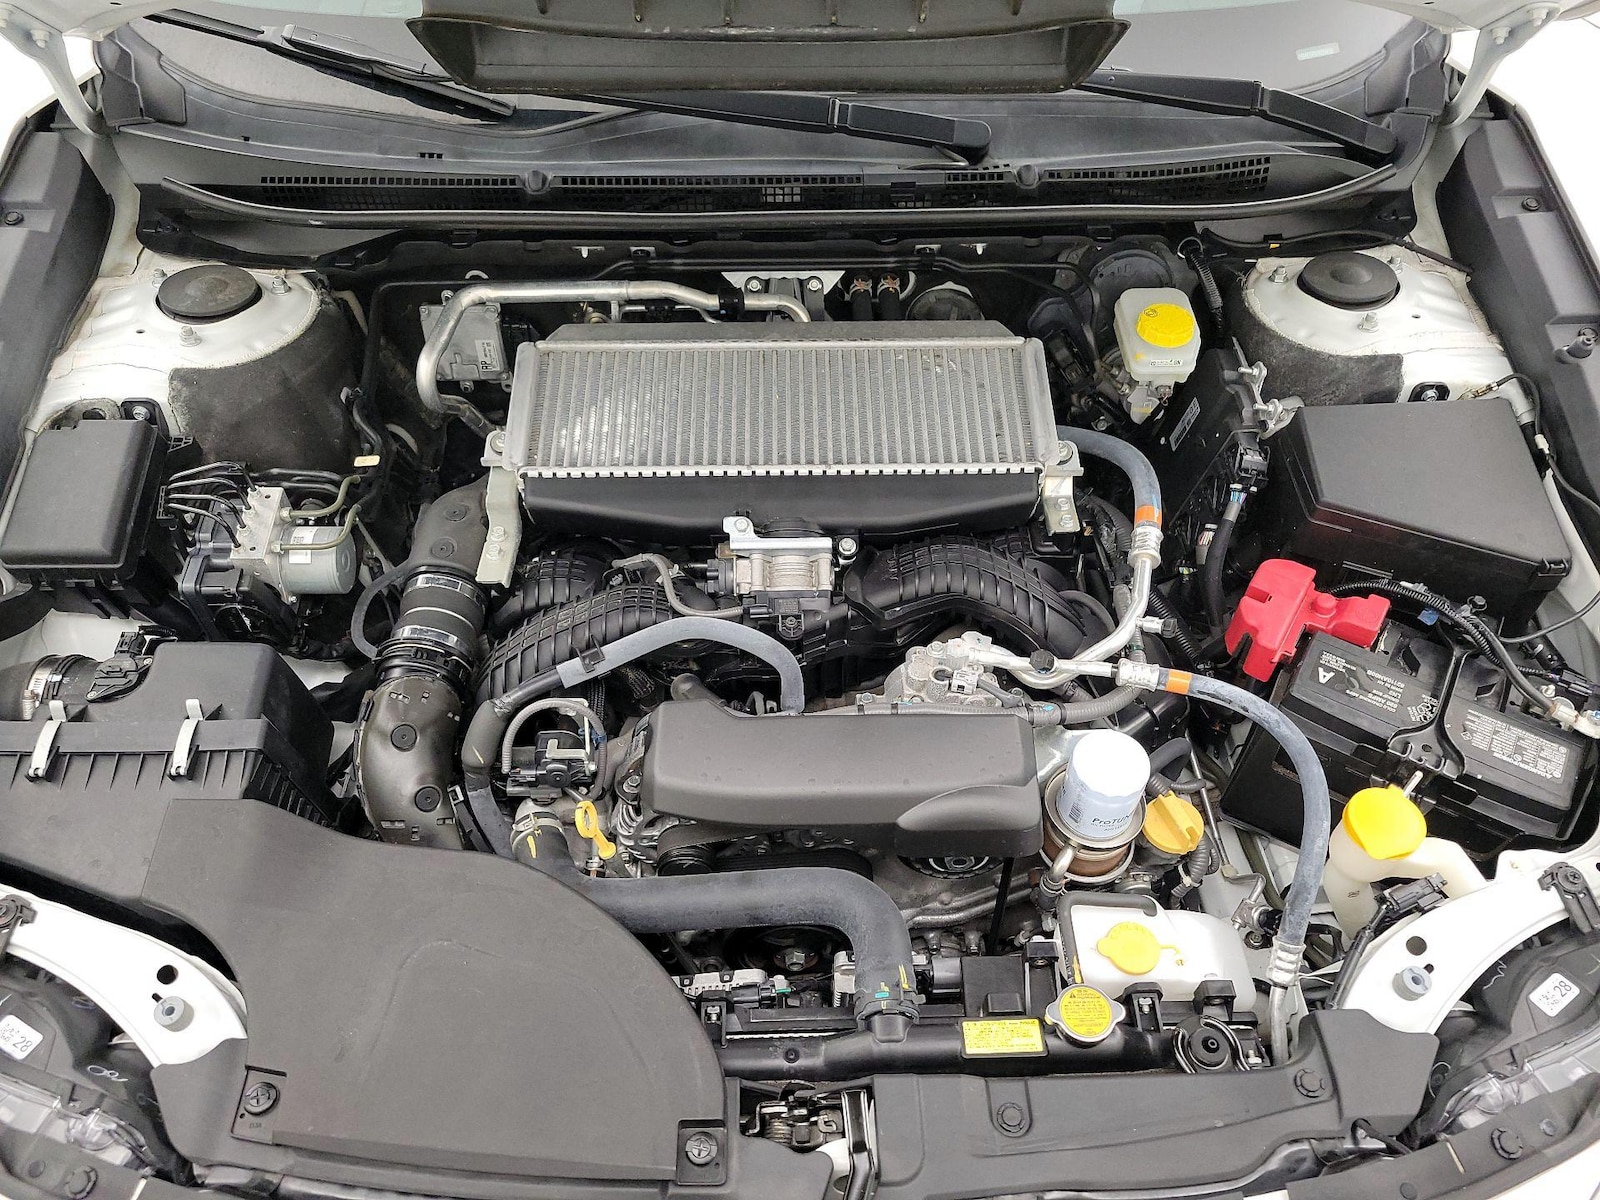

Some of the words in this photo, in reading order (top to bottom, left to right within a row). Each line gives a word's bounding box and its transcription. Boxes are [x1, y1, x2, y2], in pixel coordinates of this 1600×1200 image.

[1318, 667, 1336, 684] A
[1553, 980, 1572, 998] 28
[12, 1036, 33, 1053] 28
